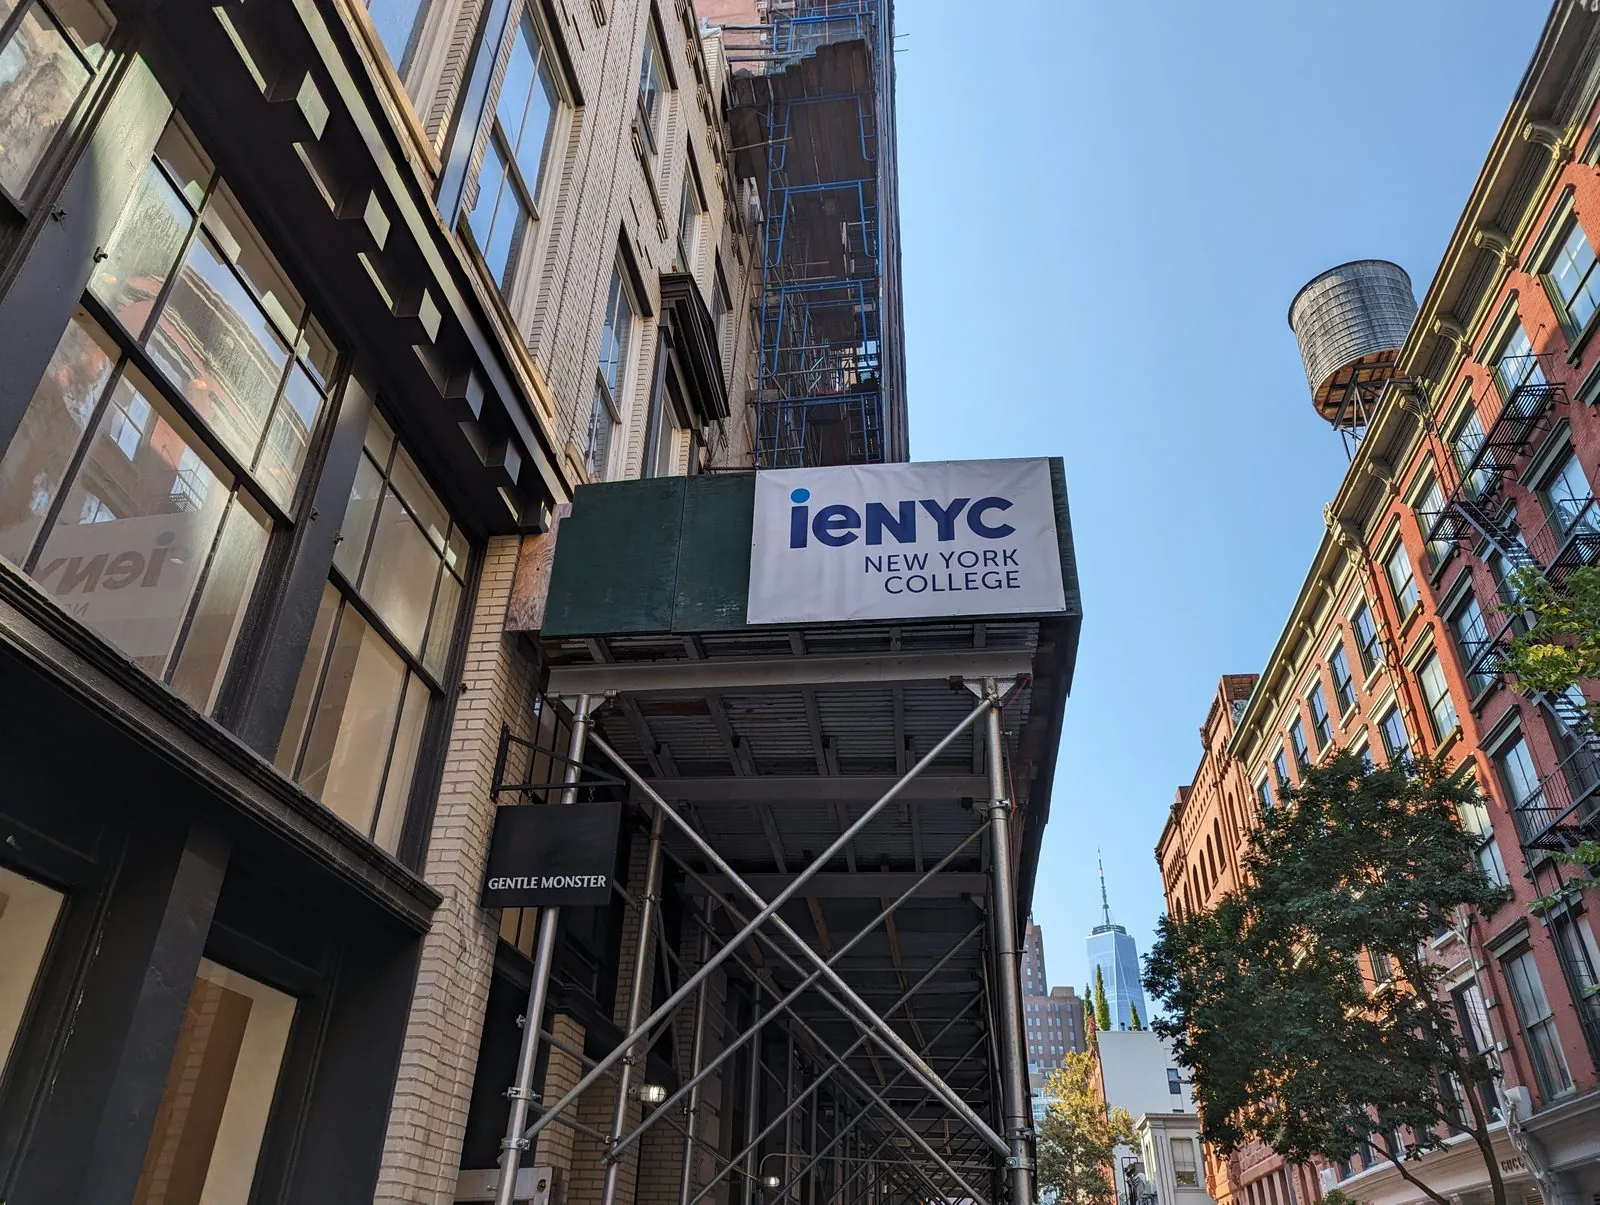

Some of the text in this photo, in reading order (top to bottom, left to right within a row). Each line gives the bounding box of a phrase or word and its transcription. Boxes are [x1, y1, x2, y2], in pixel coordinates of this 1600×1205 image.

[790, 488, 1016, 549] ieNYC
[864, 549, 1019, 573] NEW YORK
[884, 570, 1021, 594] COLLEGE
[488, 875, 606, 890] GENTLE MONSTER
[1500, 1156, 1526, 1173] GUCC
